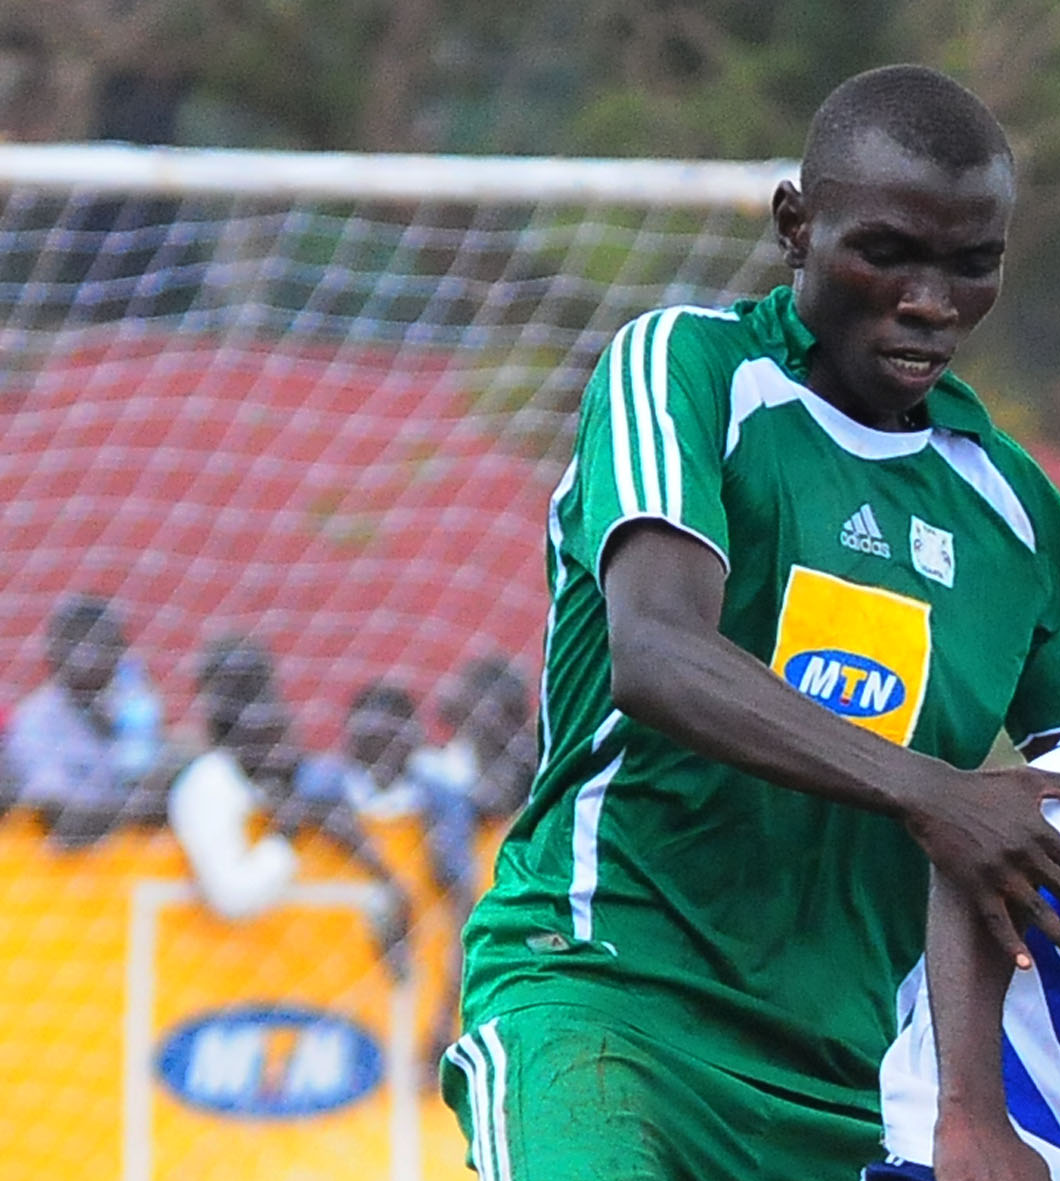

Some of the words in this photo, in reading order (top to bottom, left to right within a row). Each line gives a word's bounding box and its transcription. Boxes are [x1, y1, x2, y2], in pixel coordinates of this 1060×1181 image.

[840, 531, 891, 559] adidas
[799, 656, 897, 712] MTN
[186, 1021, 352, 1097] MTN
